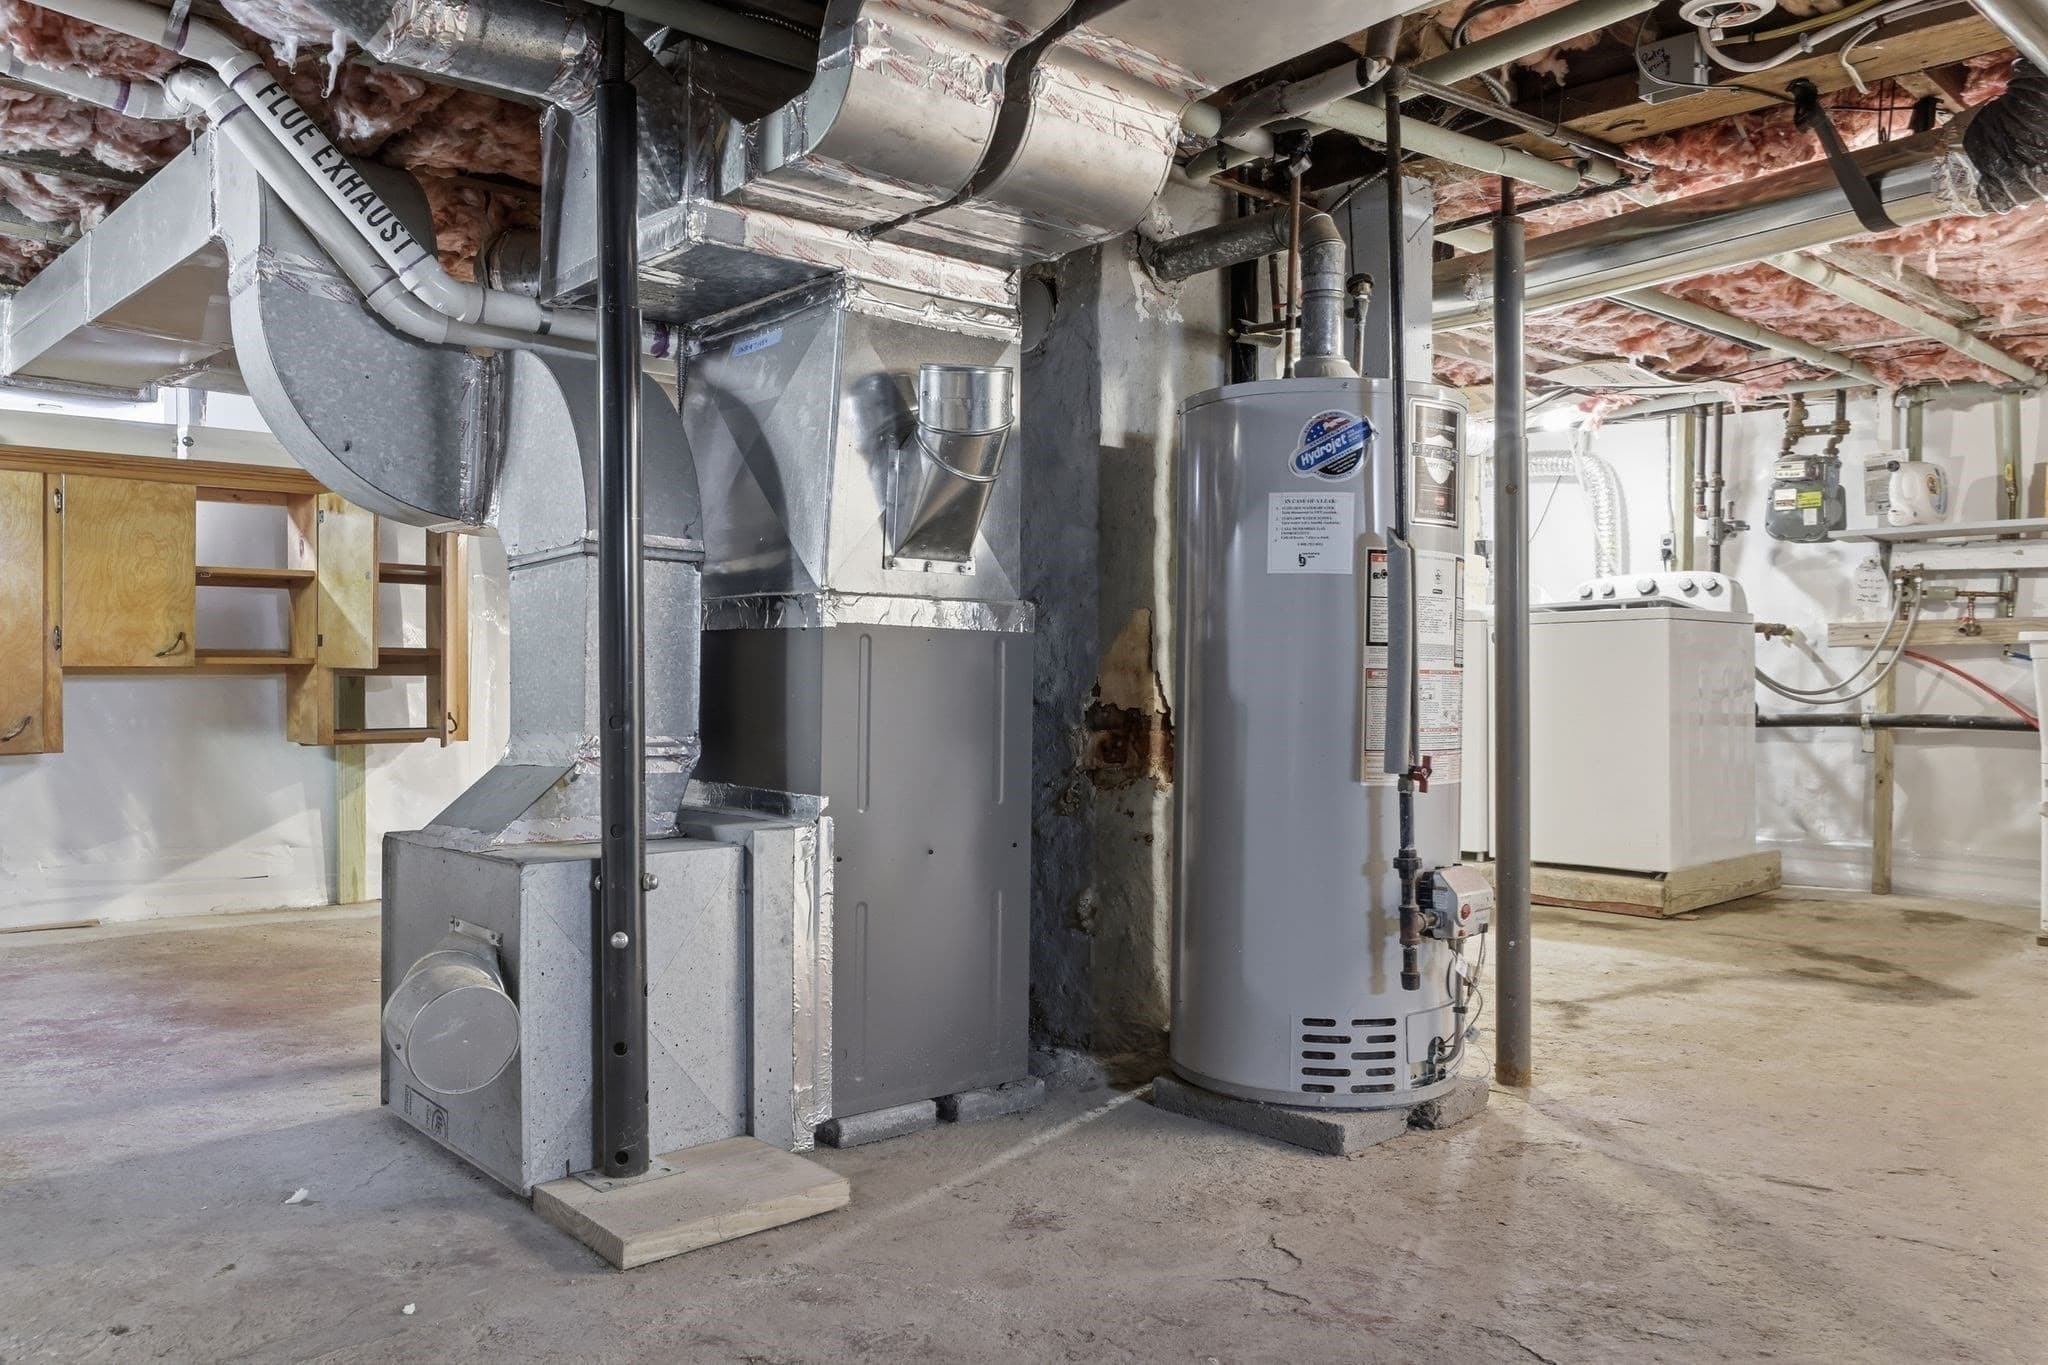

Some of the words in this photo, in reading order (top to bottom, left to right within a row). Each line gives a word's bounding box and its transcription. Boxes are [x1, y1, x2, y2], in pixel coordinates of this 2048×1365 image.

[255, 82, 321, 146] FLUE
[311, 144, 418, 254] EXHAUST
[1300, 433, 1347, 467] Hydrojet
